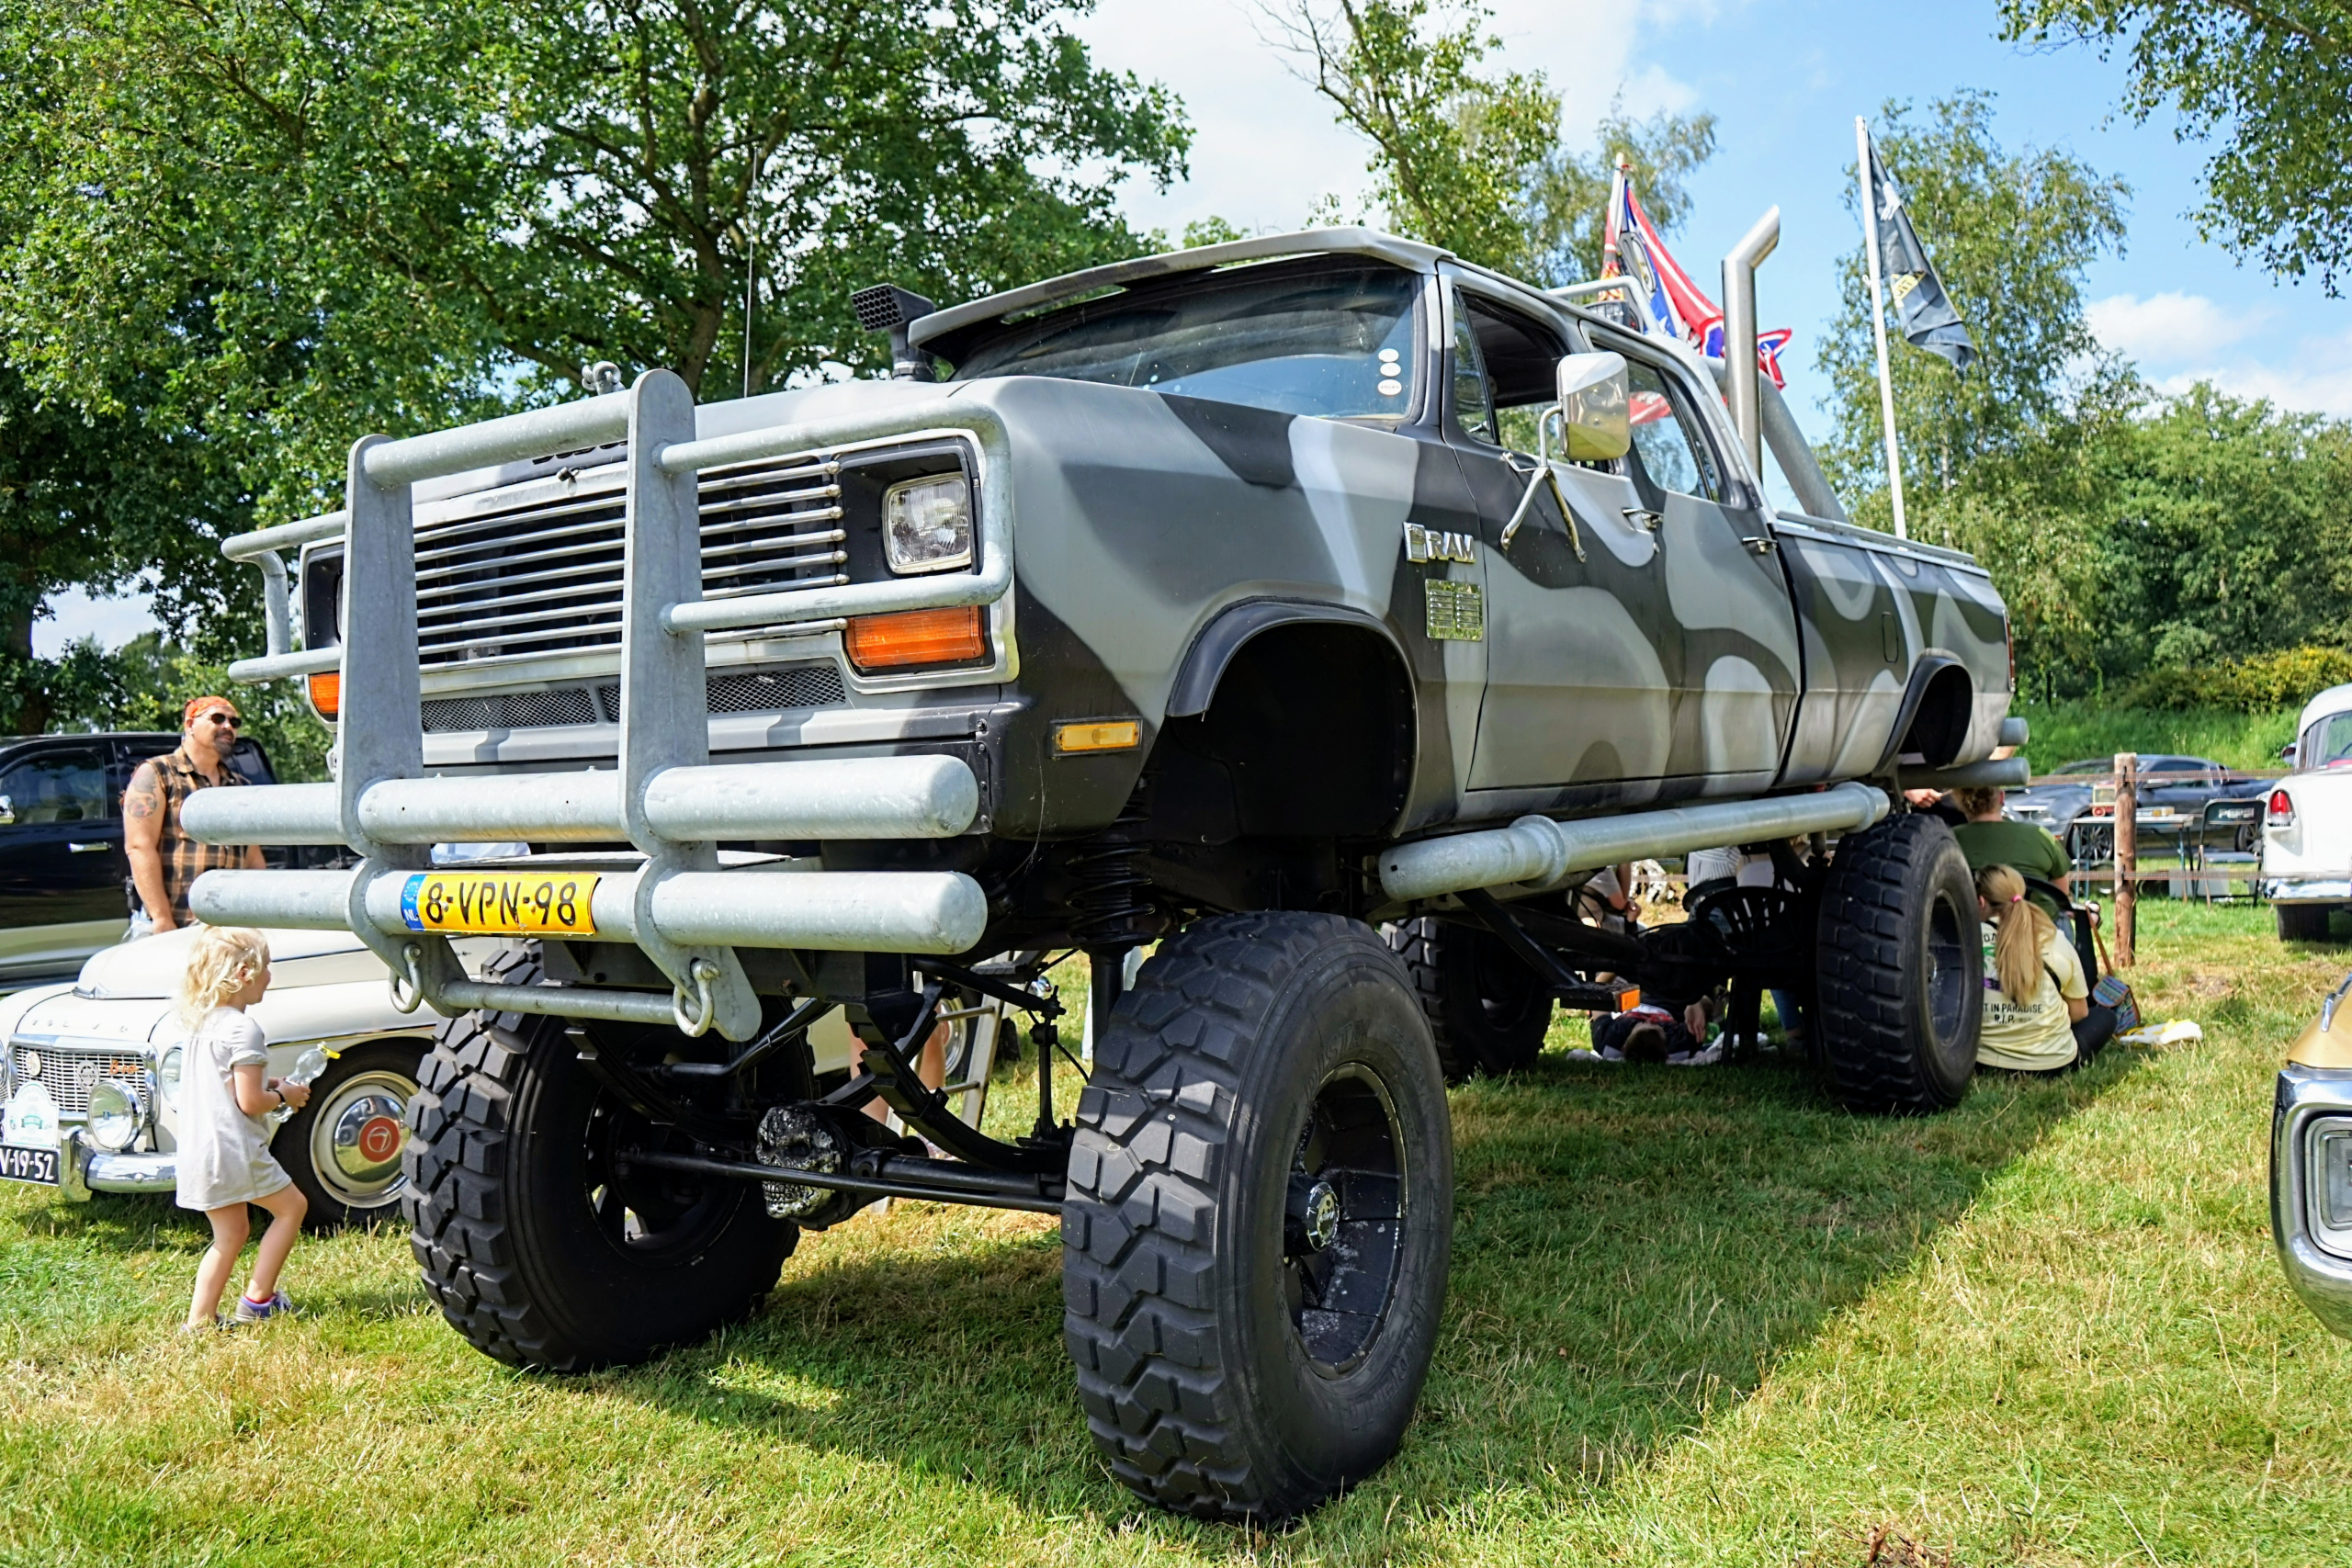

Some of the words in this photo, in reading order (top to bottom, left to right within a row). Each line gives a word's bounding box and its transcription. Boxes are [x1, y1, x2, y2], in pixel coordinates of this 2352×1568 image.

[1425, 529, 1476, 564] RAM
[2218, 807, 2255, 819] PEPSI
[404, 908, 418, 922] NL
[425, 881, 577, 927] 8-VPN-98
[1990, 1003, 2000, 1012] IN
[0, 1148, 55, 1181] V-19-52
